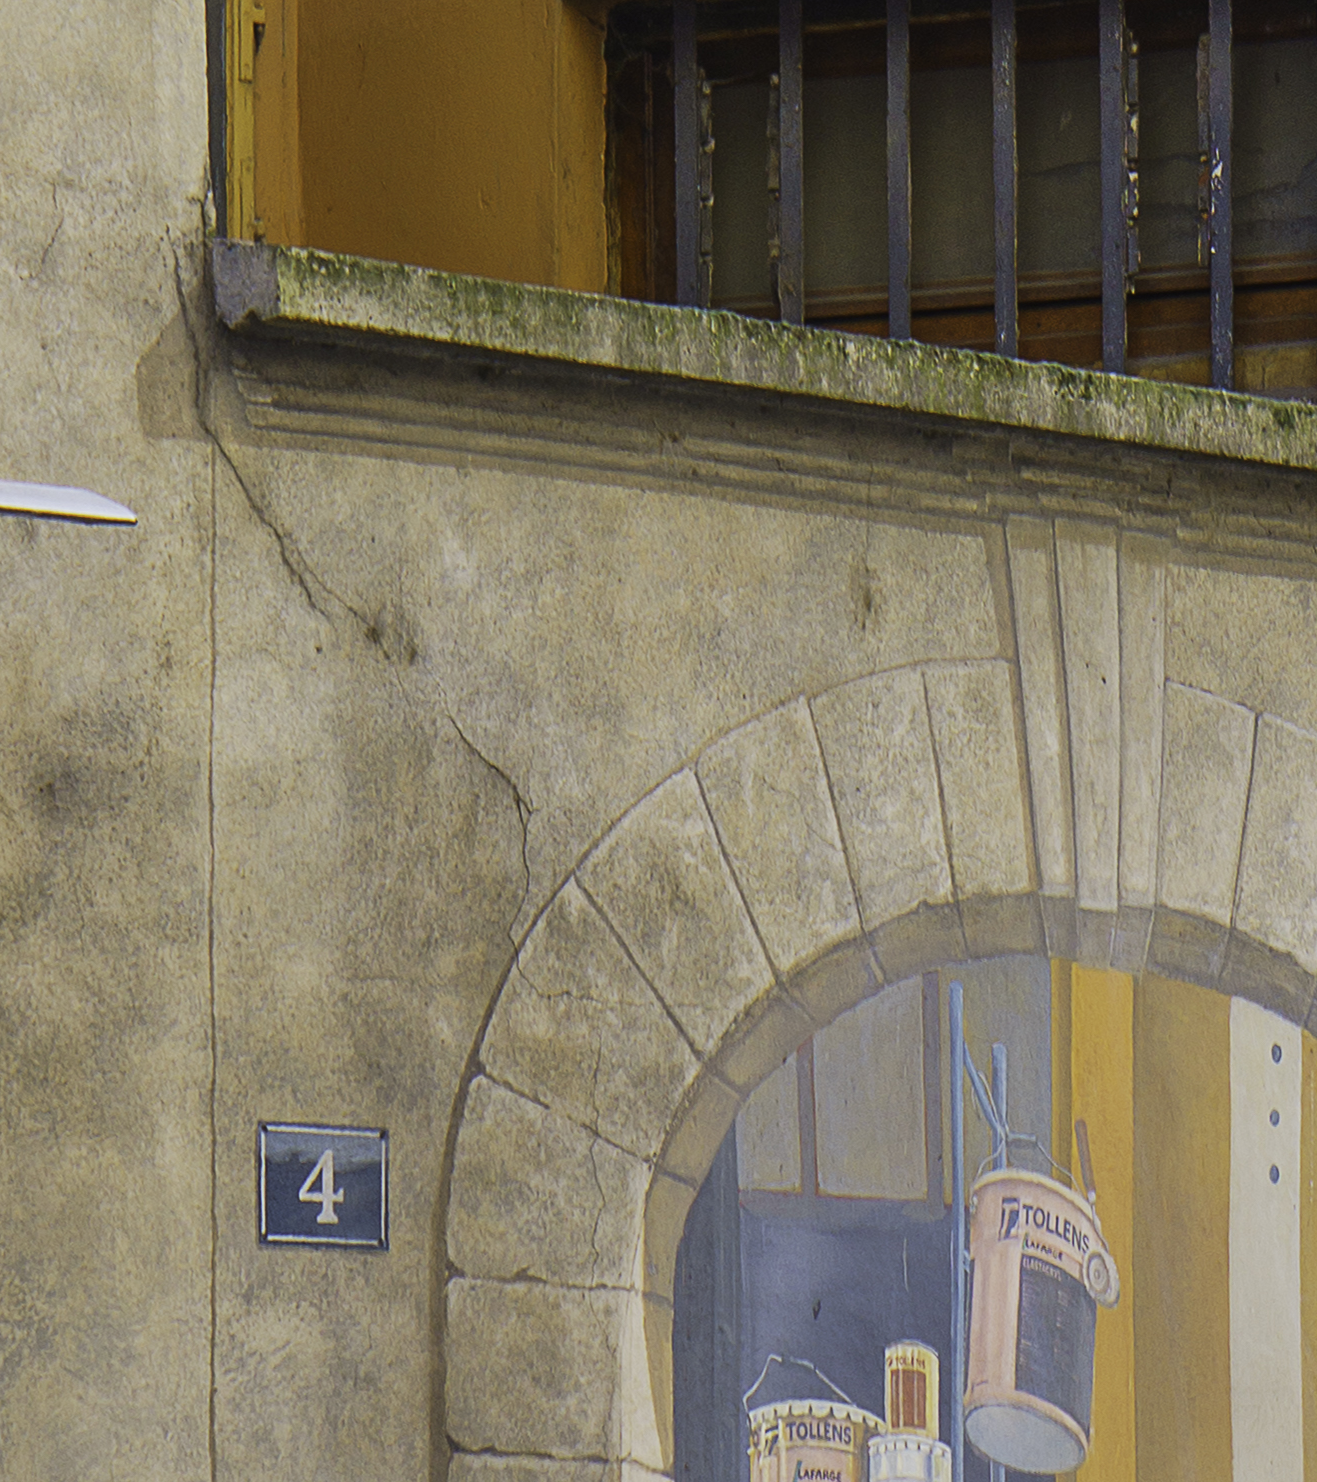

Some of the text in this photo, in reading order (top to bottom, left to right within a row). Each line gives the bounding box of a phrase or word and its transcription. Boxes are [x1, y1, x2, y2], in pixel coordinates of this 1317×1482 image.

[299, 1149, 344, 1224] 4
[1023, 1204, 1089, 1254] TOLLENS
[786, 1420, 851, 1445] TOLLENS
